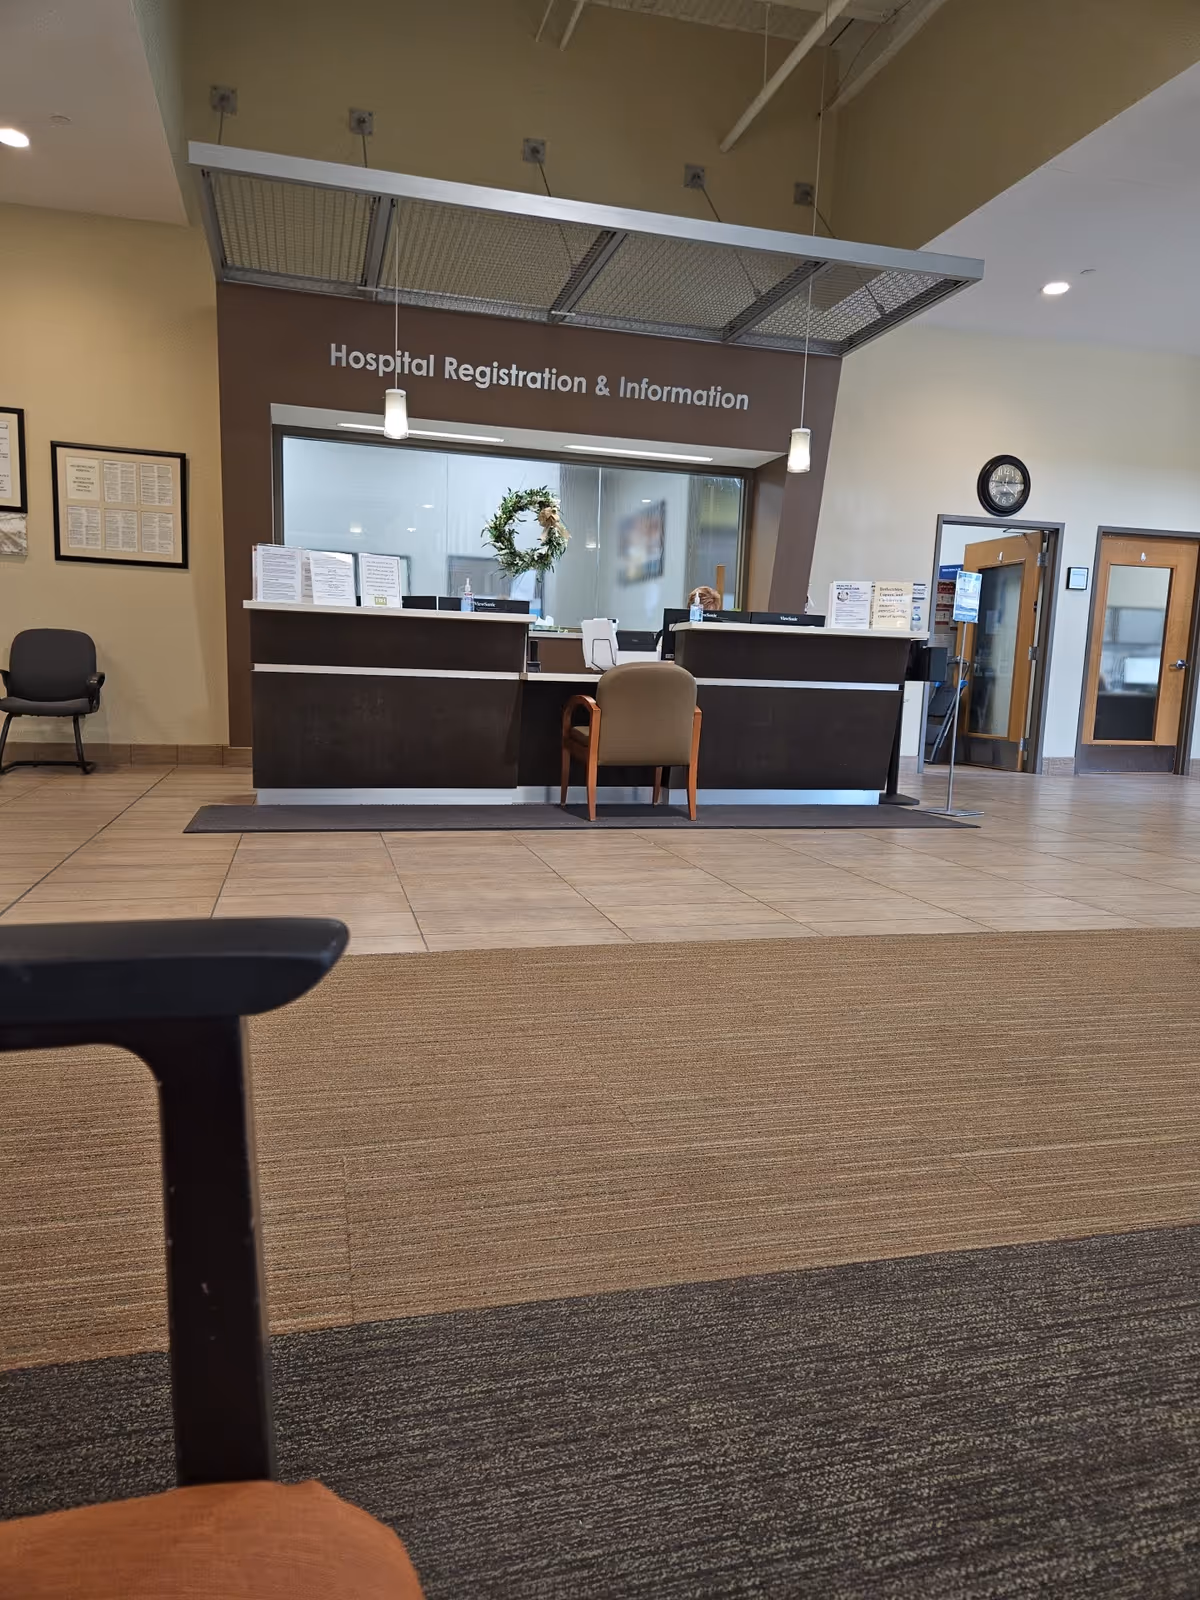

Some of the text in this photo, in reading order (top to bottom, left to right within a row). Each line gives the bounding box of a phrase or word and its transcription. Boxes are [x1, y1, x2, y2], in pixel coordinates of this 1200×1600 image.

[330, 343, 750, 411] Hospital Registration & Information
